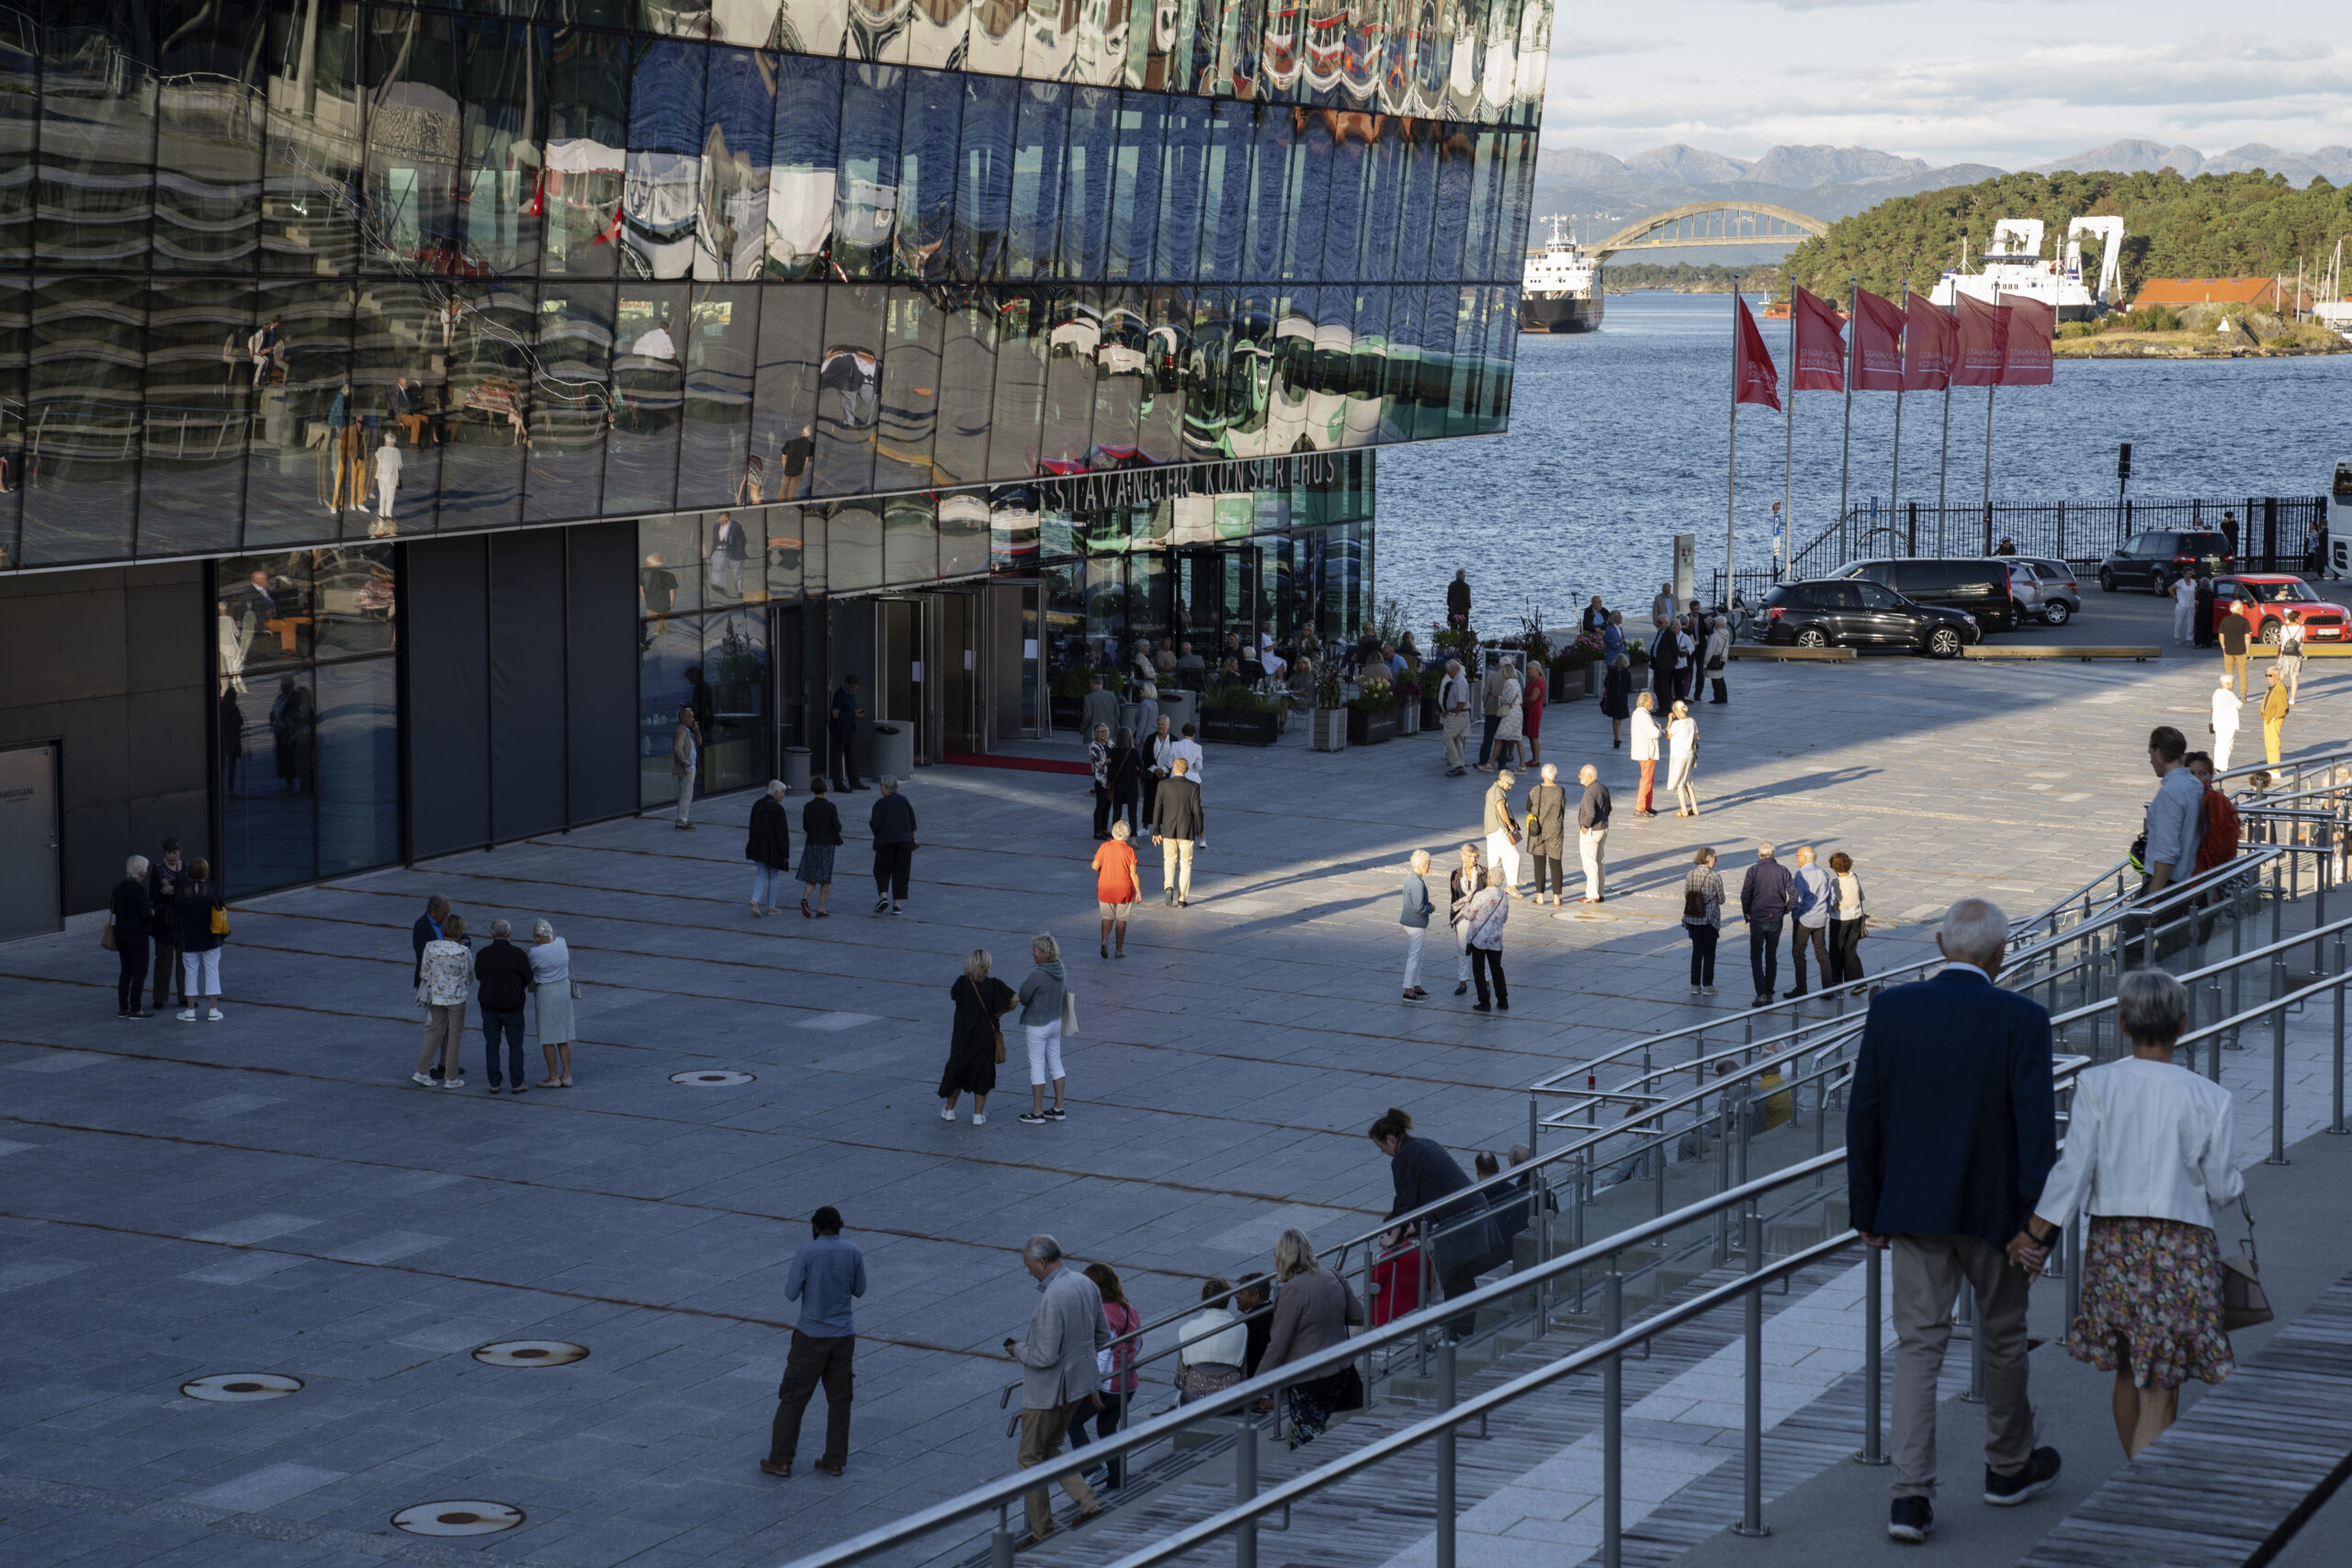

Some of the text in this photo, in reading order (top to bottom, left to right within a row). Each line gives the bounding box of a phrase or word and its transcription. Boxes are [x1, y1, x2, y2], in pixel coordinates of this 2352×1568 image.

[1054, 452, 1335, 513] STAVANGER KONSERTHUS
[1774, 517, 1780, 534] P
